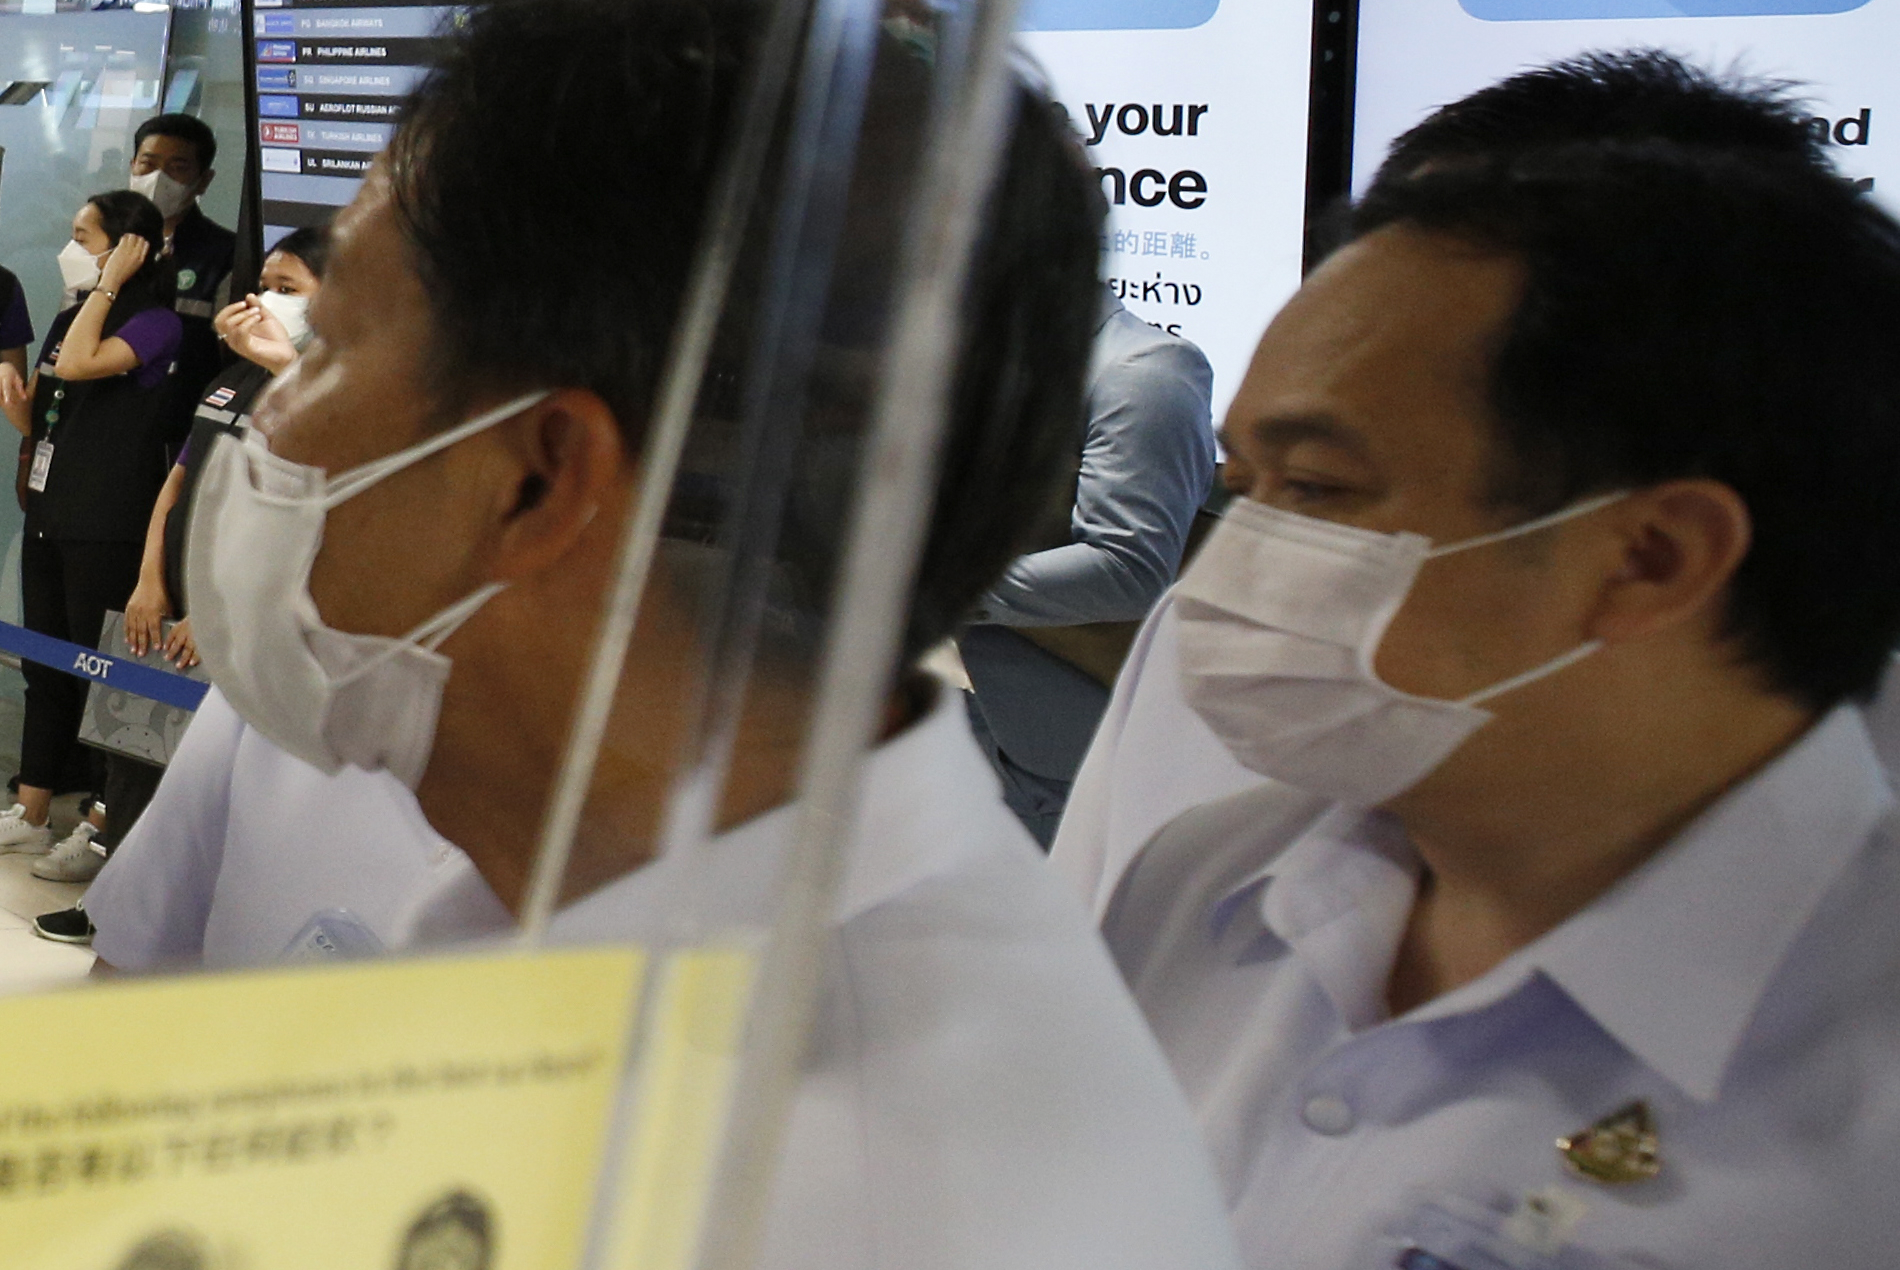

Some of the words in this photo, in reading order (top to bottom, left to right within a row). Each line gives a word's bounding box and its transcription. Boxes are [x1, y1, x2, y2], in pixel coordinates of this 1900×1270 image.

[353, 47, 387, 57] AIRLINES
[1085, 103, 1209, 146] your
[73, 652, 113, 679] AOT
